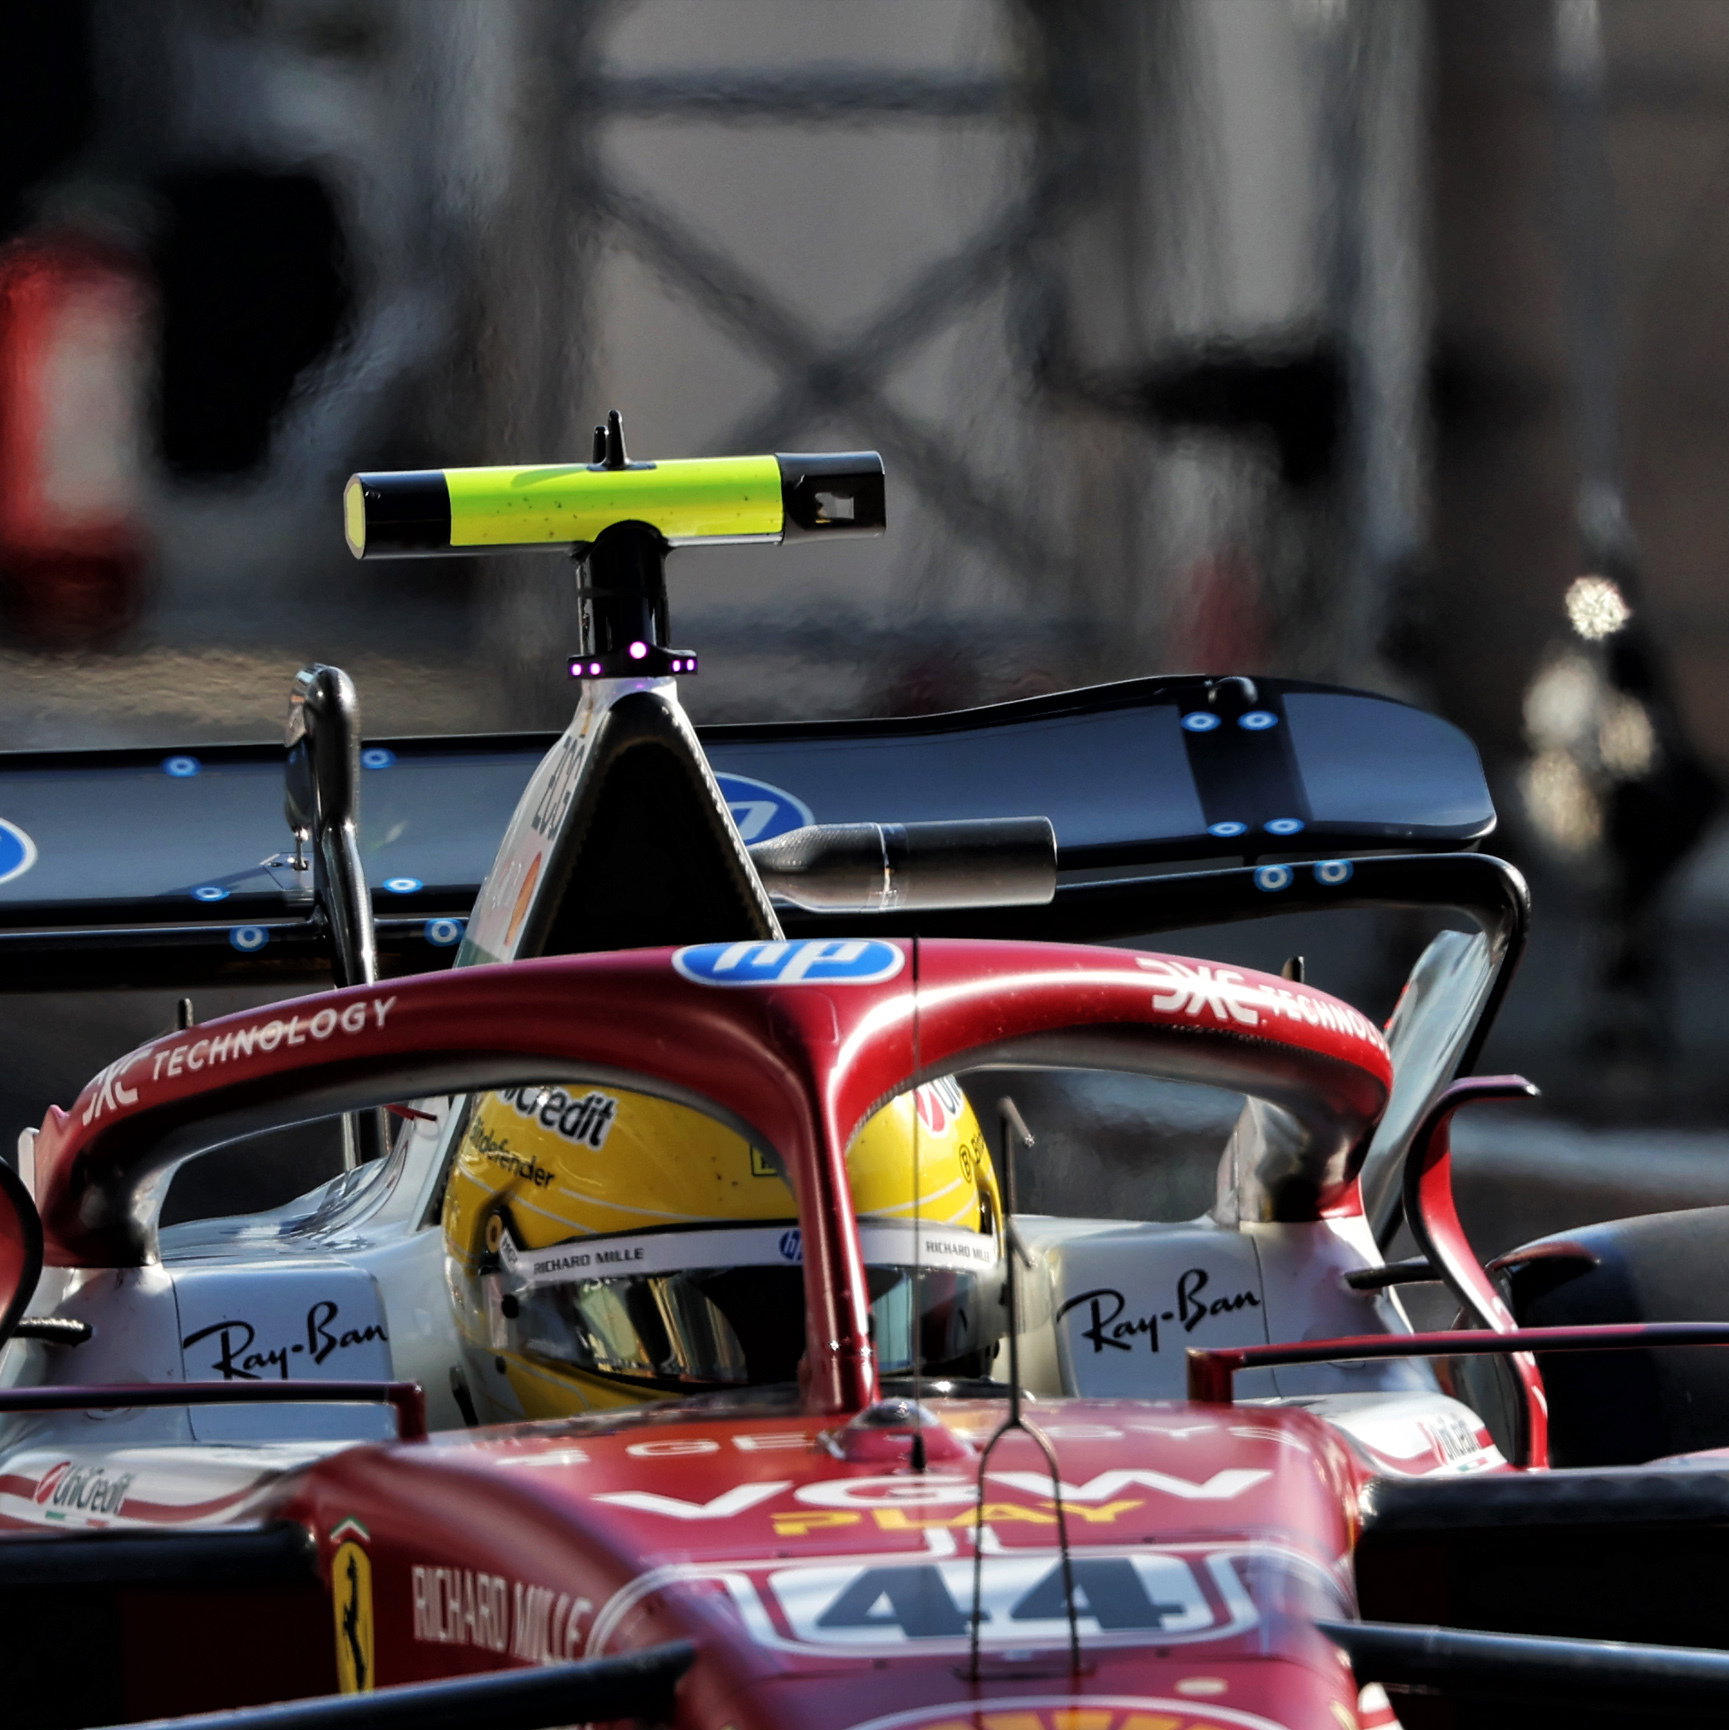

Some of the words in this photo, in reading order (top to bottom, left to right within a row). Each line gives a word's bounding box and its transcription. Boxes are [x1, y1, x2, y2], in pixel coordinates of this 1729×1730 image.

[151, 997, 398, 1081] TECHNOLOGY
[533, 1255, 591, 1276] RICHARD
[595, 1247, 645, 1265] MILLE
[182, 1300, 388, 1381] Ray-Ban
[1056, 1268, 1262, 1352] Ray-Ban
[589, 1466, 1274, 1520] VGW
[772, 1499, 1147, 1536] PLAY
[411, 1565, 510, 1651] RICHARD
[815, 1555, 1188, 1642] 44
